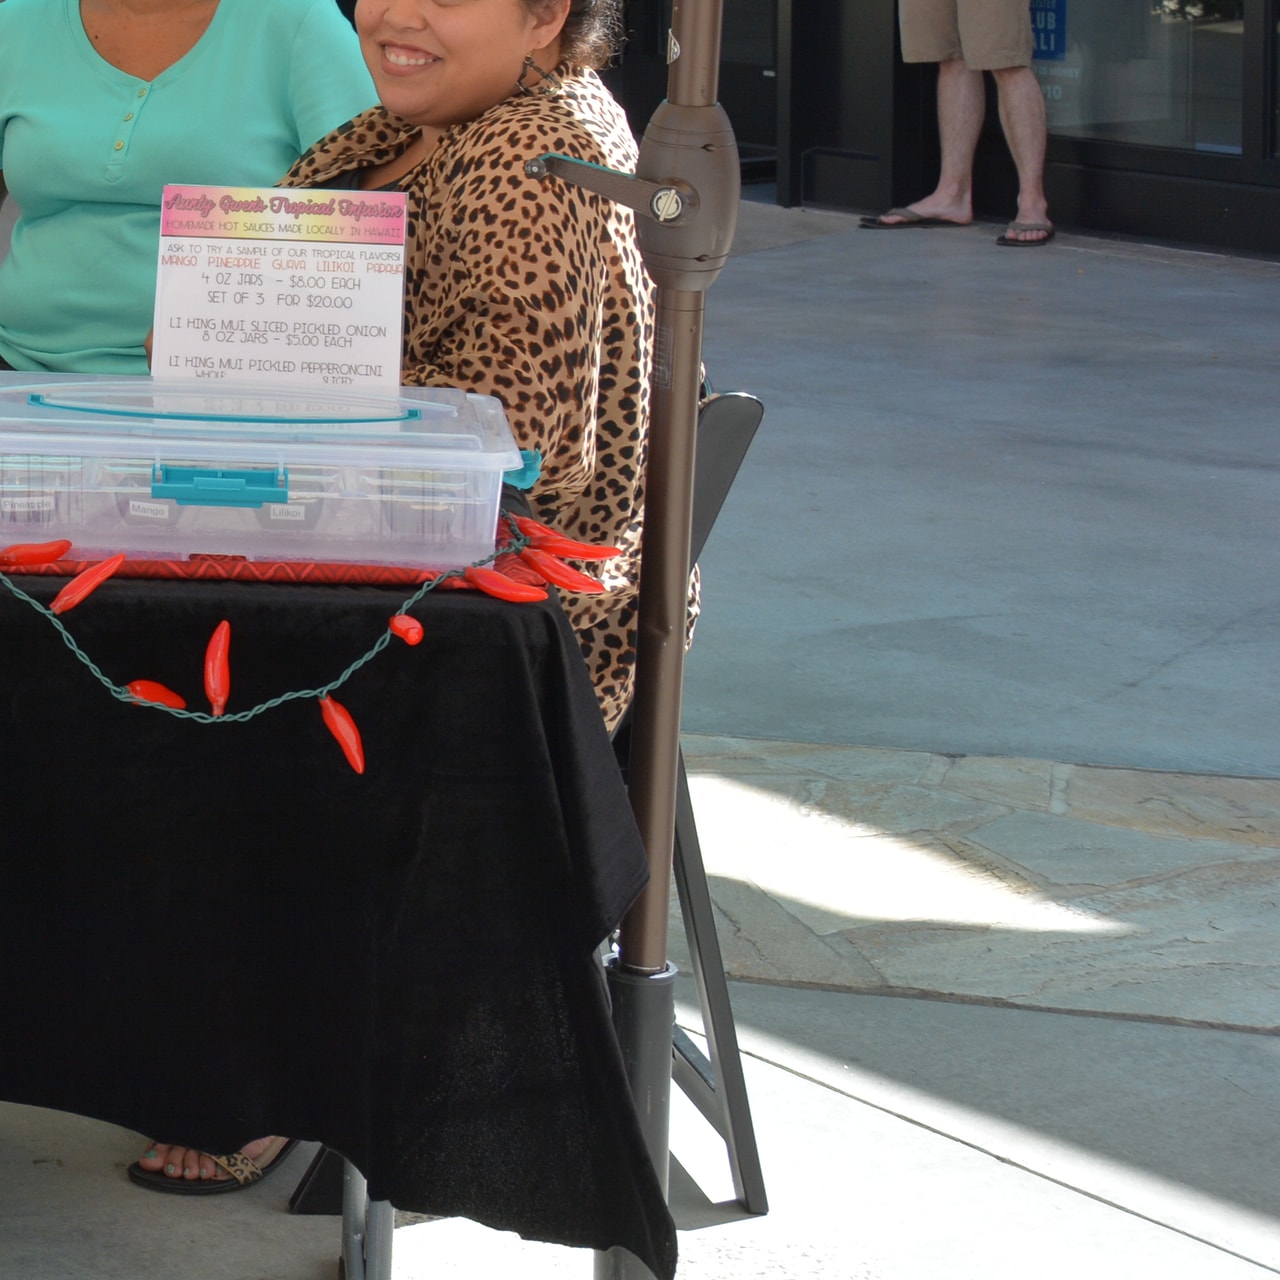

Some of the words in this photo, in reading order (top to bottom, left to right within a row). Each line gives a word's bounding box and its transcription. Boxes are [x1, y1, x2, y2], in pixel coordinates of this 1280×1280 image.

[165, 193, 216, 217] Aunty
[219, 195, 268, 215] Gwen's
[270, 196, 335, 219] Tropical
[338, 198, 403, 221] Infusion
[166, 219, 215, 231] HOMEMADE
[219, 221, 238, 232] HOT
[243, 222, 275, 233] SAUCES
[278, 223, 302, 234] MADE
[307, 224, 344, 236] LOCALLY
[350, 226, 361, 236] IN
[364, 227, 401, 238] HAWAII
[167, 243, 184, 253] ASK
[189, 244, 202, 253] TO
[207, 245, 223, 254] TRY
[226, 246, 233, 254] A
[237, 246, 268, 256] SAMPLE
[272, 247, 284, 257] OF
[288, 248, 307, 258] OUR
[311, 249, 355, 260] TROPICAL
[359, 251, 401, 261] FLAVORS!
[161, 254, 197, 266] MANGO
[208, 256, 261, 269] PINEAPPLE
[272, 258, 306, 271] GUAVA
[317, 261, 354, 273] LILIKOI
[367, 263, 403, 275] PAPAYA
[202, 272, 209, 283] 4
[216, 273, 231, 285] OZ
[237, 274, 264, 286] JARS
[290, 275, 326, 289] $8.00
[331, 278, 361, 290] EACH
[207, 291, 227, 304] SET
[234, 292, 249, 305] OF
[255, 293, 265, 305] 3
[277, 294, 301, 307] FOR
[306, 295, 353, 309] $20.00
[169, 317, 182, 329] LI
[187, 318, 217, 330] HING
[221, 319, 245, 331] MUI
[251, 320, 289, 333] SLICED
[293, 322, 341, 335] PICKLED
[345, 325, 386, 337] ONION
[202, 330, 210, 342] 8
[216, 331, 235, 343] OZ
[240, 332, 269, 345] JARS
[285, 334, 320, 347] $5.00
[324, 336, 353, 348] EACH
[169, 355, 180, 367] LI
[185, 356, 215, 369] HING
[219, 358, 243, 370] MUI
[249, 359, 296, 373] PICKLED
[301, 362, 384, 377] PEPPERONCINI
[3, 499, 51, 510] Pineapple
[132, 504, 165, 516] Mango
[272, 507, 301, 518] Lilikoi
